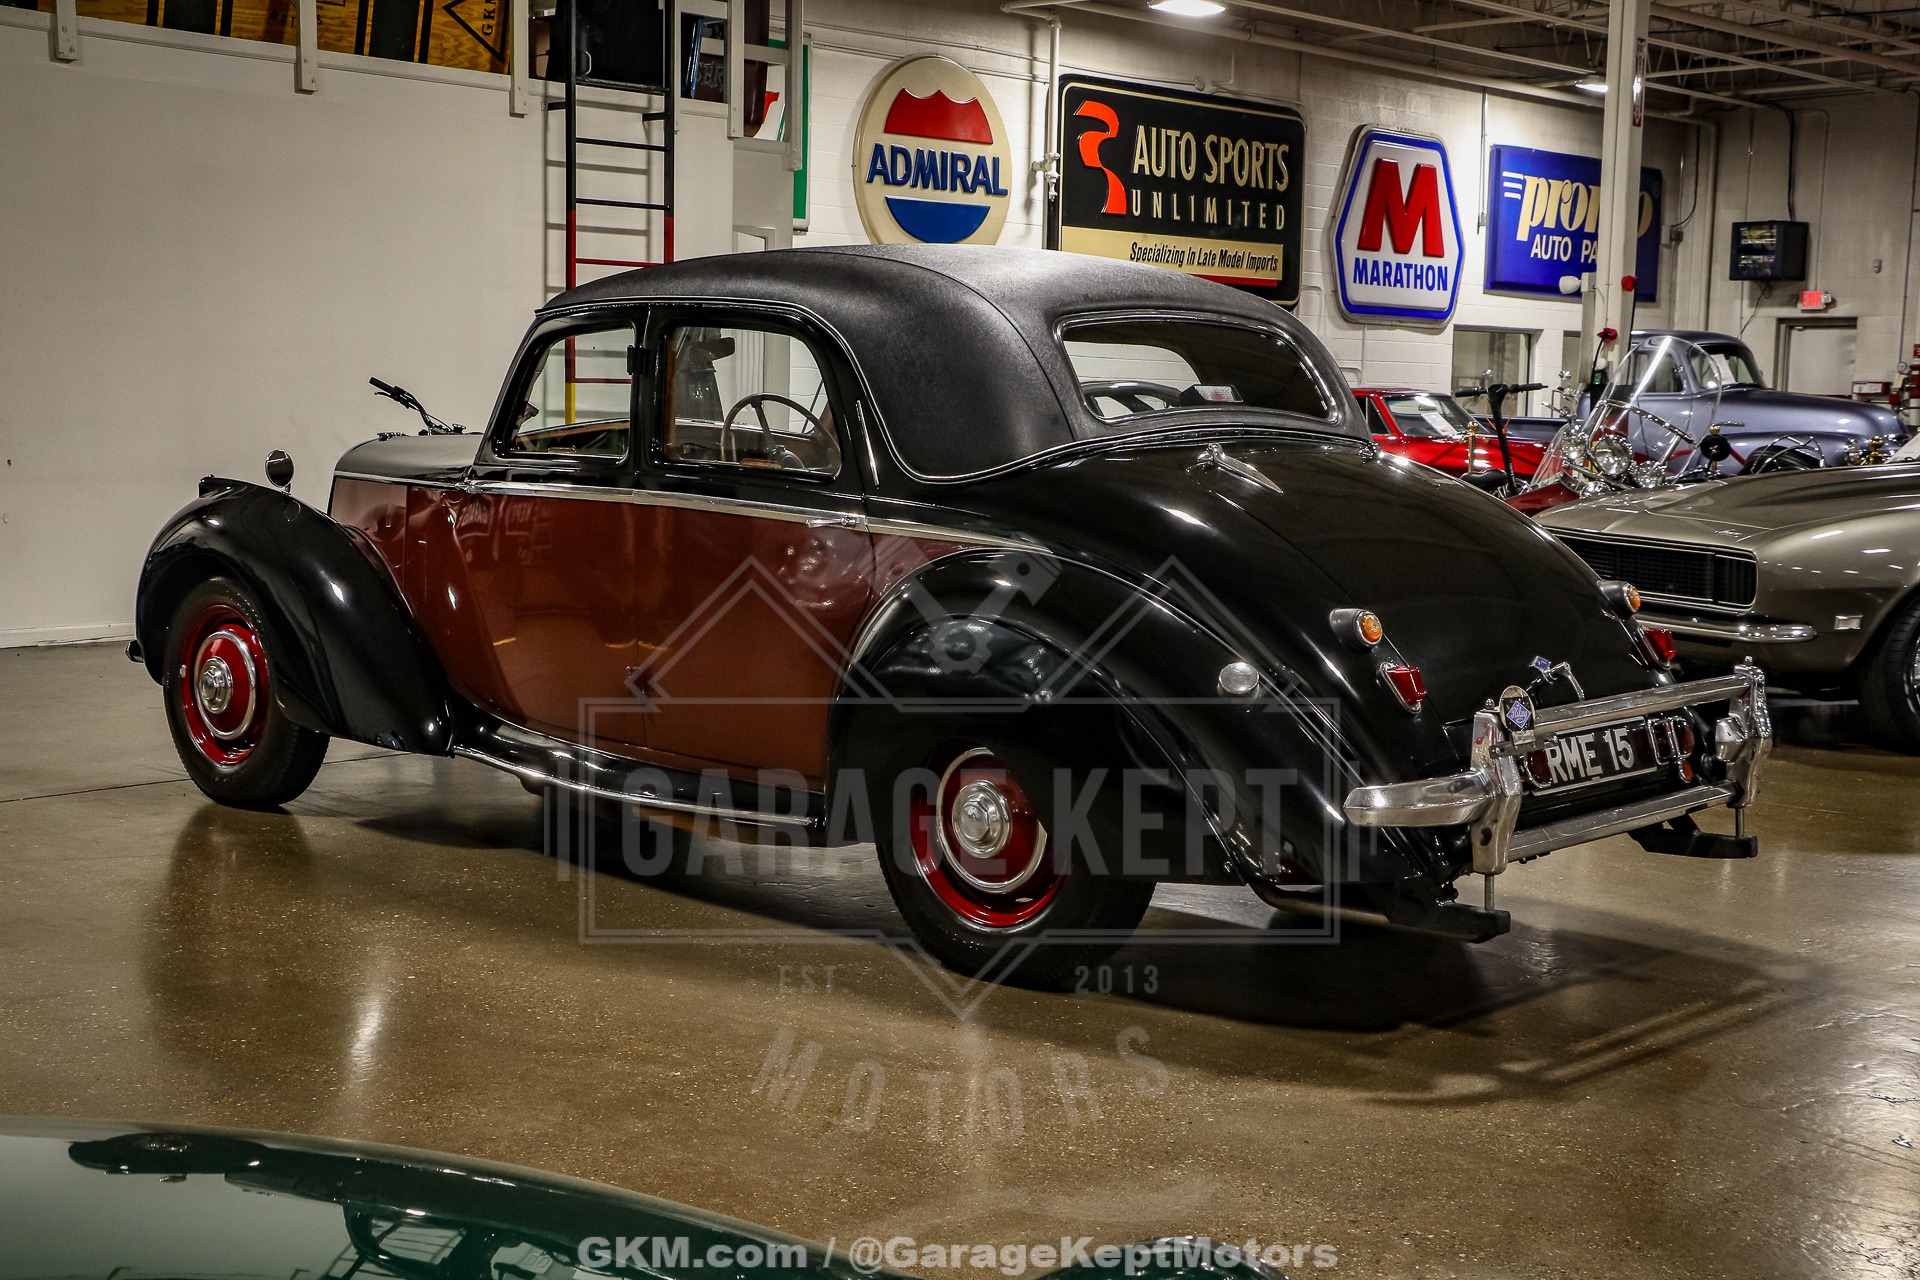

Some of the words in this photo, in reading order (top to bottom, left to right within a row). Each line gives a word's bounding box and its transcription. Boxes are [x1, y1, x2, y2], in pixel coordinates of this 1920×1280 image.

[866, 142, 1009, 196] ADMIRAL
[1132, 124, 1197, 181] AUTO
[1202, 134, 1290, 192] SPORTS
[1131, 189, 1286, 231] UNLIMITED
[1357, 157, 1445, 258] M
[1516, 175, 1653, 241] proo
[1130, 241, 1185, 267] Specializing
[1186, 246, 1196, 265] In
[1197, 248, 1217, 267] Late
[1217, 249, 1244, 268] Model
[1246, 251, 1278, 273] Imports
[1353, 257, 1448, 291] MARATHON
[1530, 233, 1572, 262] AUTO
[1545, 734, 1602, 783] RME
[1604, 728, 1635, 771] 15
